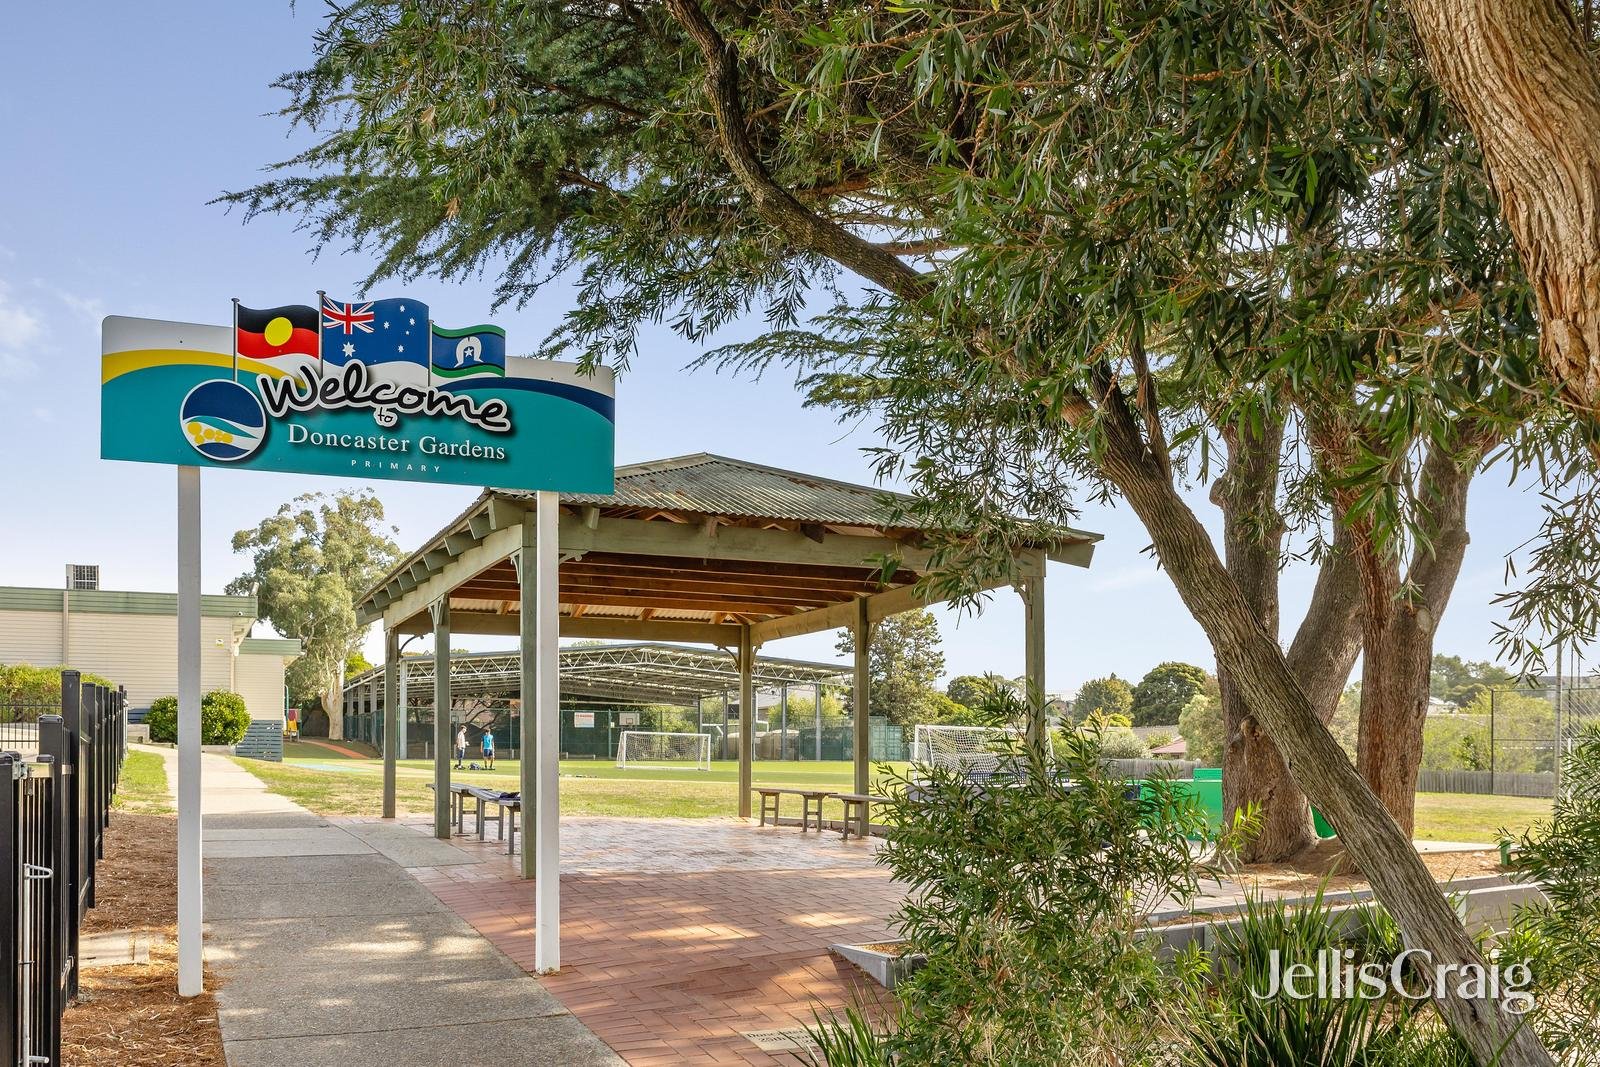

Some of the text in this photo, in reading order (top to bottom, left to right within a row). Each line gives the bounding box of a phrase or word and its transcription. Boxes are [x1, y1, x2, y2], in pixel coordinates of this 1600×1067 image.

[258, 361, 508, 429] Welcome
[377, 405, 394, 423] to
[287, 423, 506, 460] Doncaster Gardens
[351, 459, 440, 473] PRIMARY
